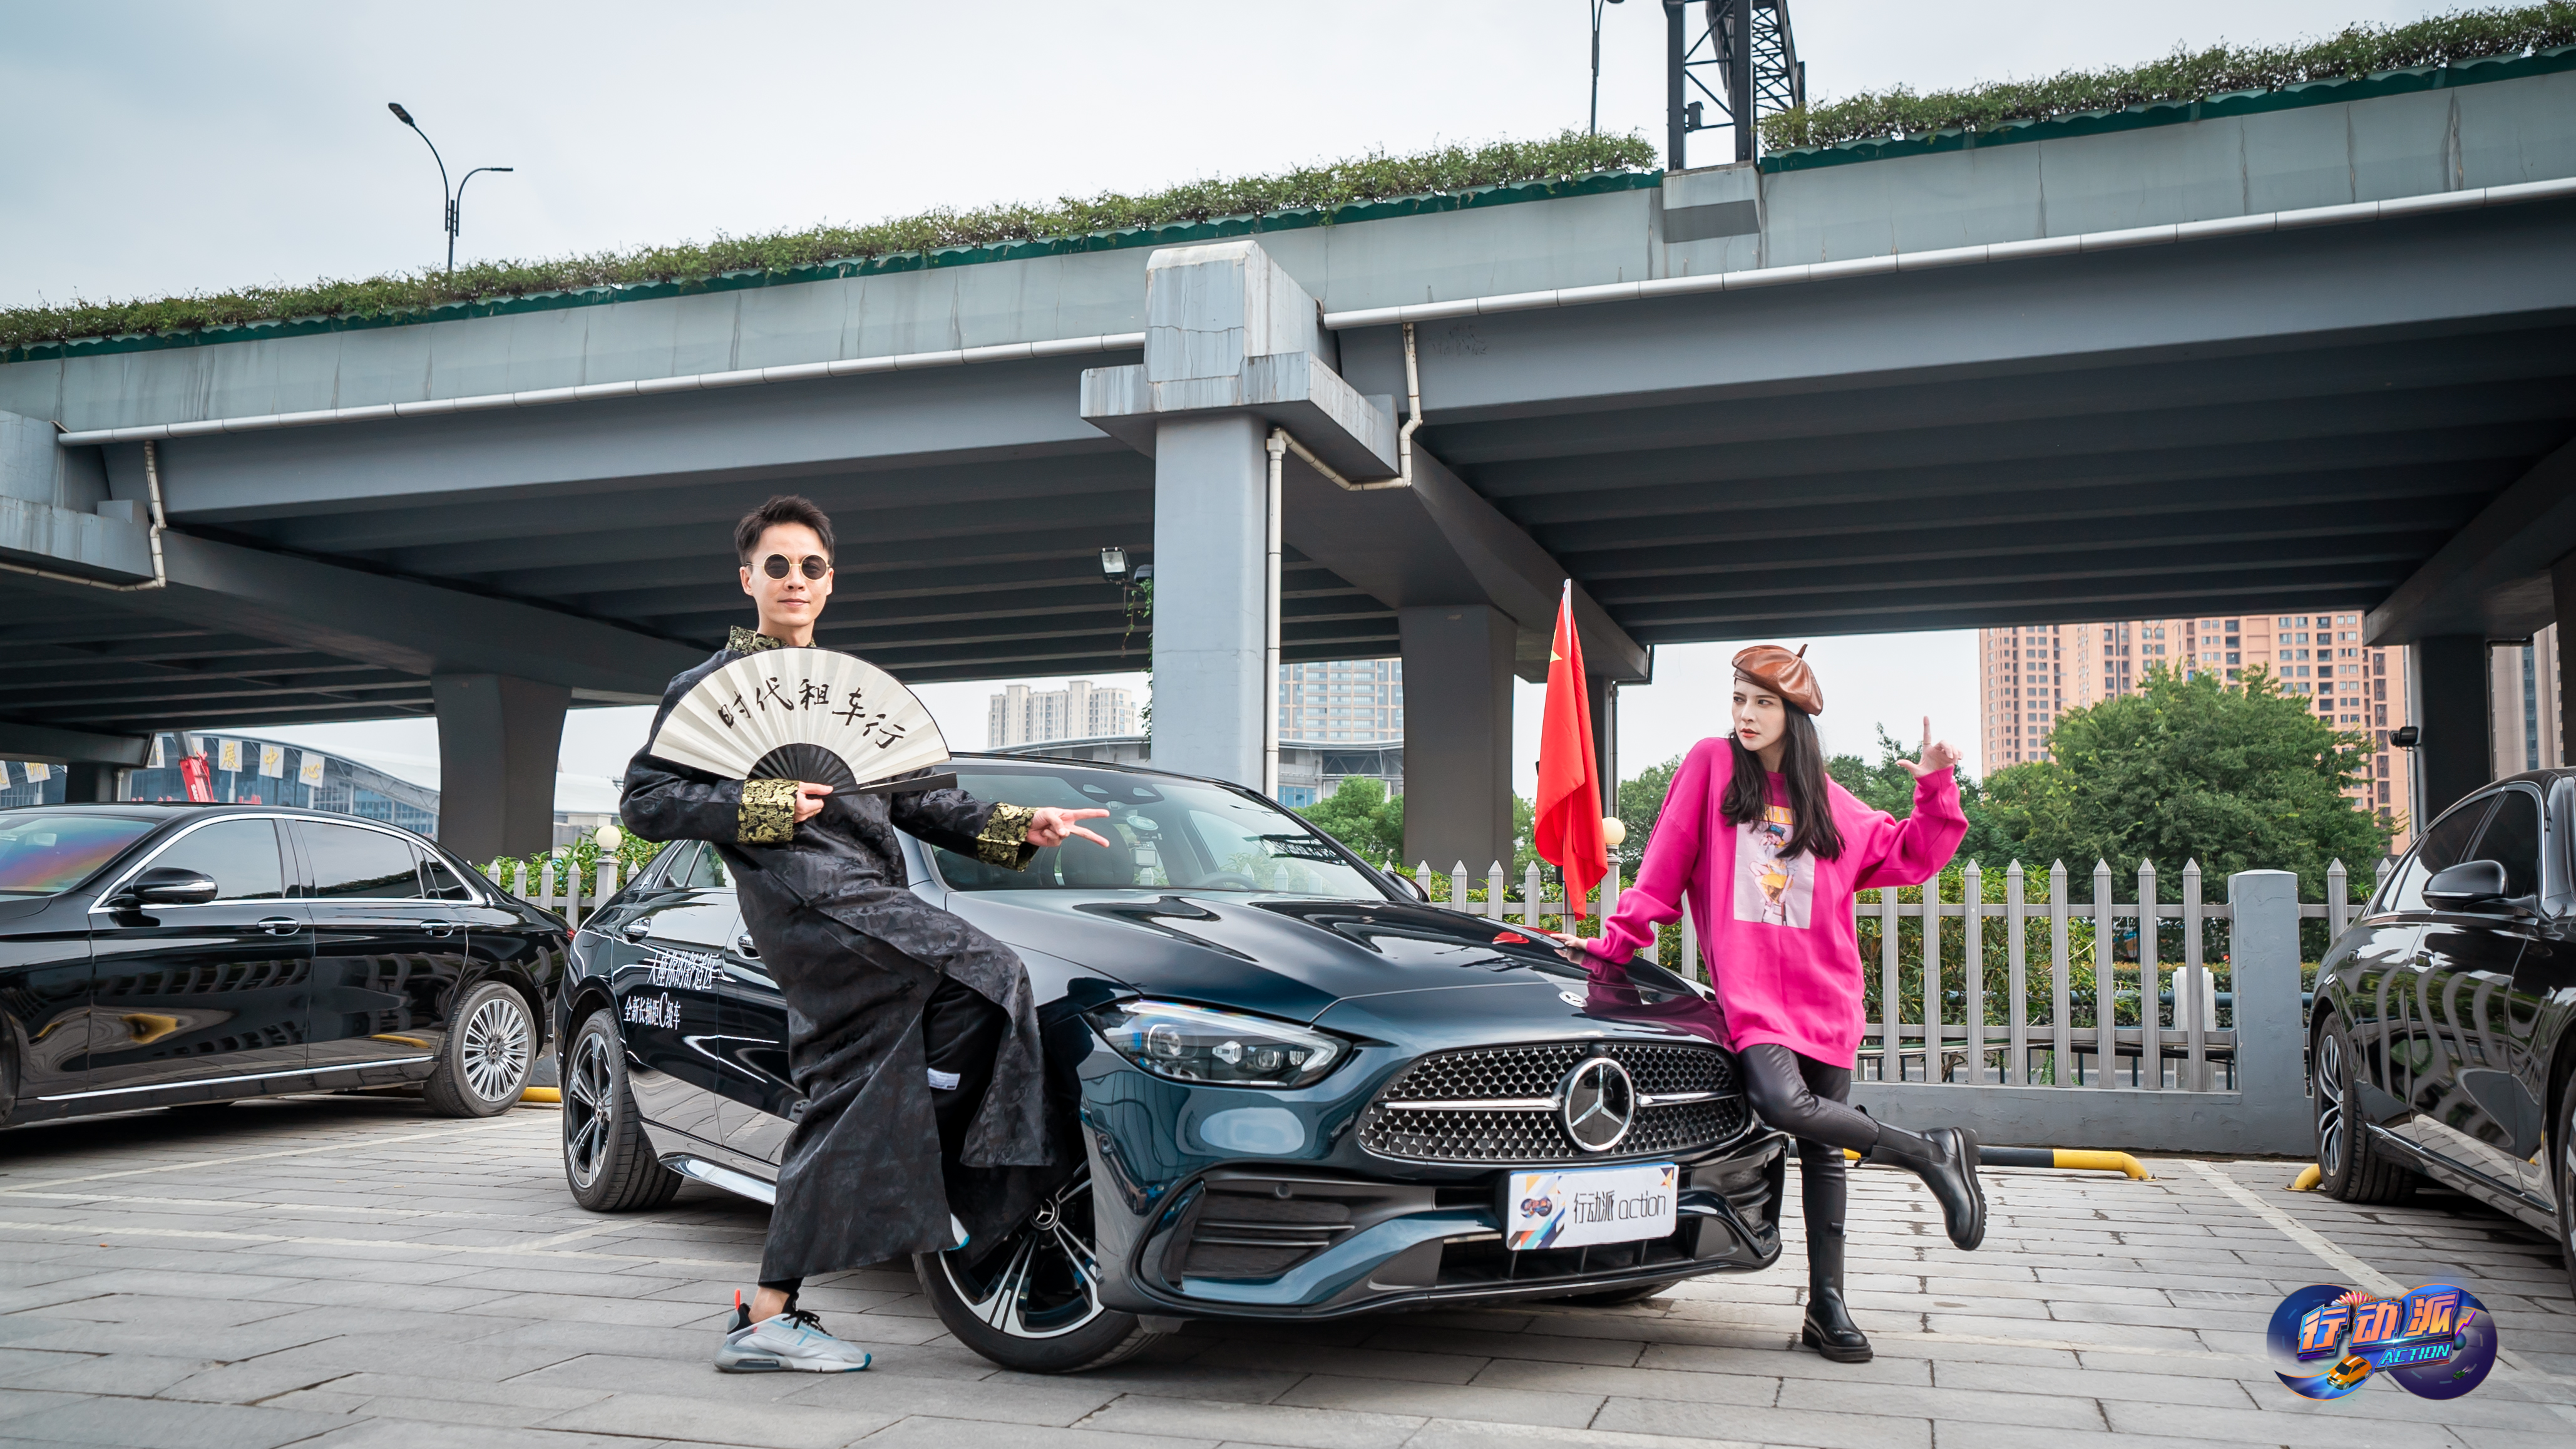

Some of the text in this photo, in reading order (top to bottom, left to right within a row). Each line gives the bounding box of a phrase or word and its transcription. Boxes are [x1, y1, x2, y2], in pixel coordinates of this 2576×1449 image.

[718, 678, 906, 748] 时代租车行
[623, 992, 680, 1030] 全新长轴距C级车
[1574, 1190, 1614, 1224] 行动派
[1619, 1190, 1666, 1219] action
